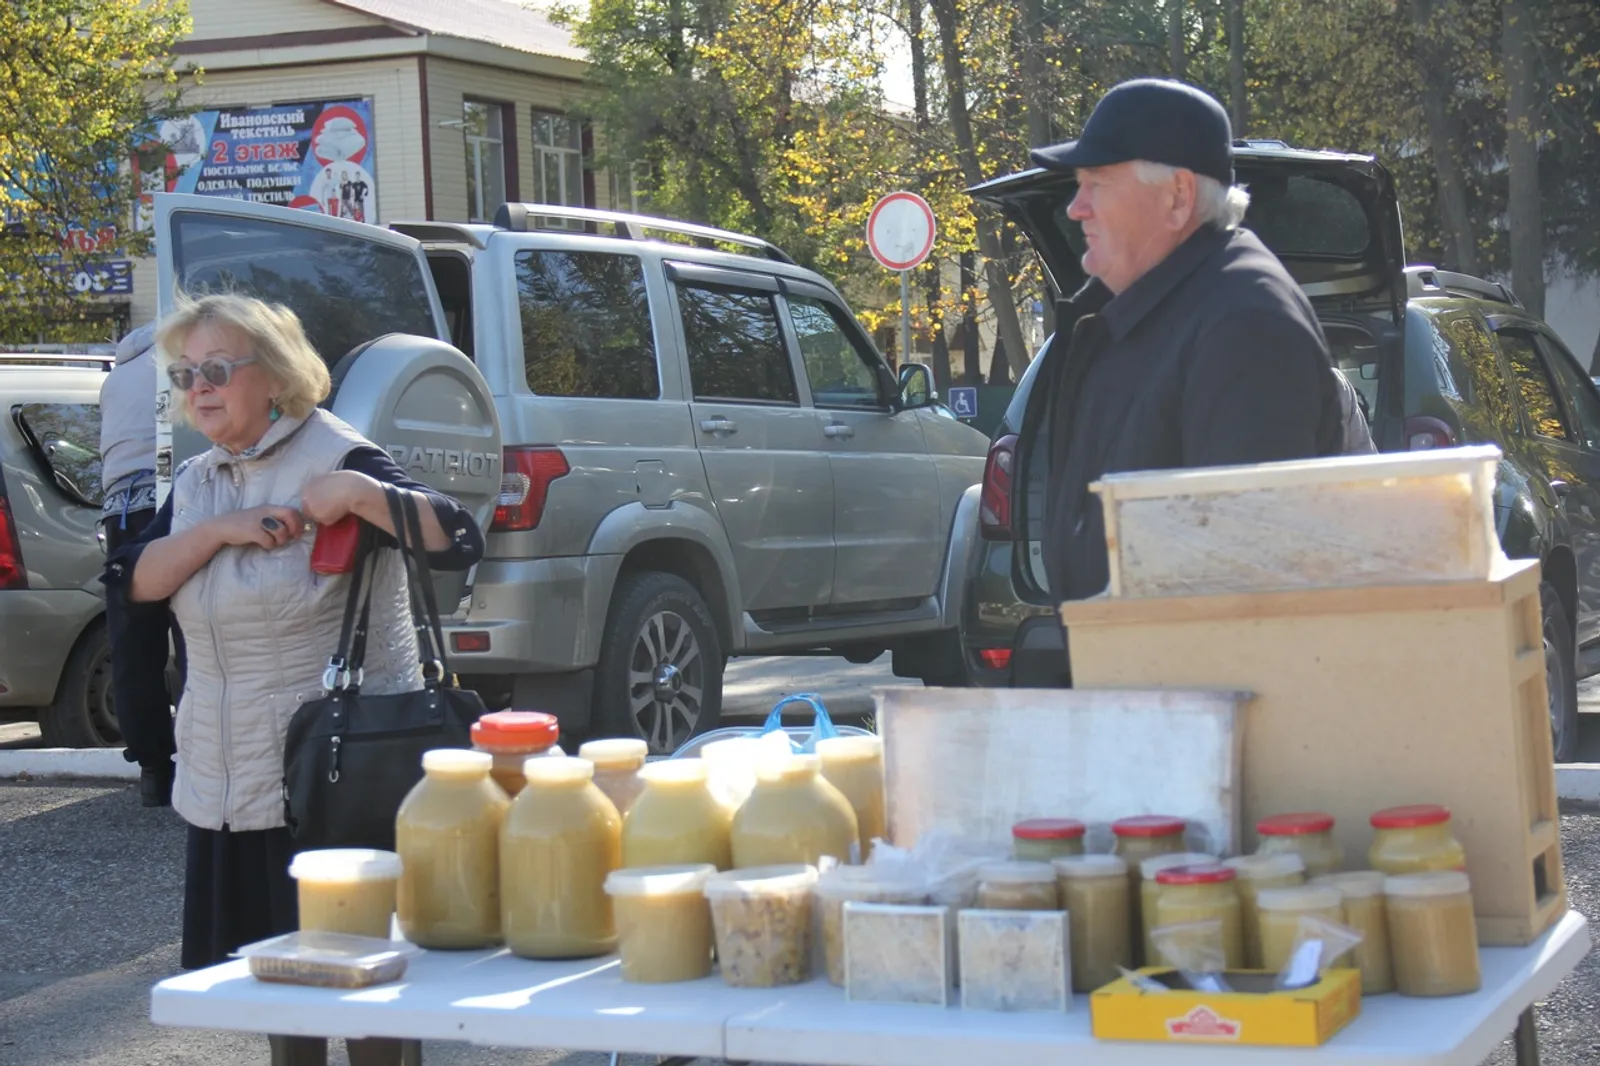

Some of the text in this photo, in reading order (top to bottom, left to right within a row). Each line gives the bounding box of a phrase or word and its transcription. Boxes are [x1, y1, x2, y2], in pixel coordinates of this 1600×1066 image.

[220, 109, 305, 128] Ивановский
[212, 140, 300, 163] 2 этаж
[386, 445, 498, 478] PATRIOT
